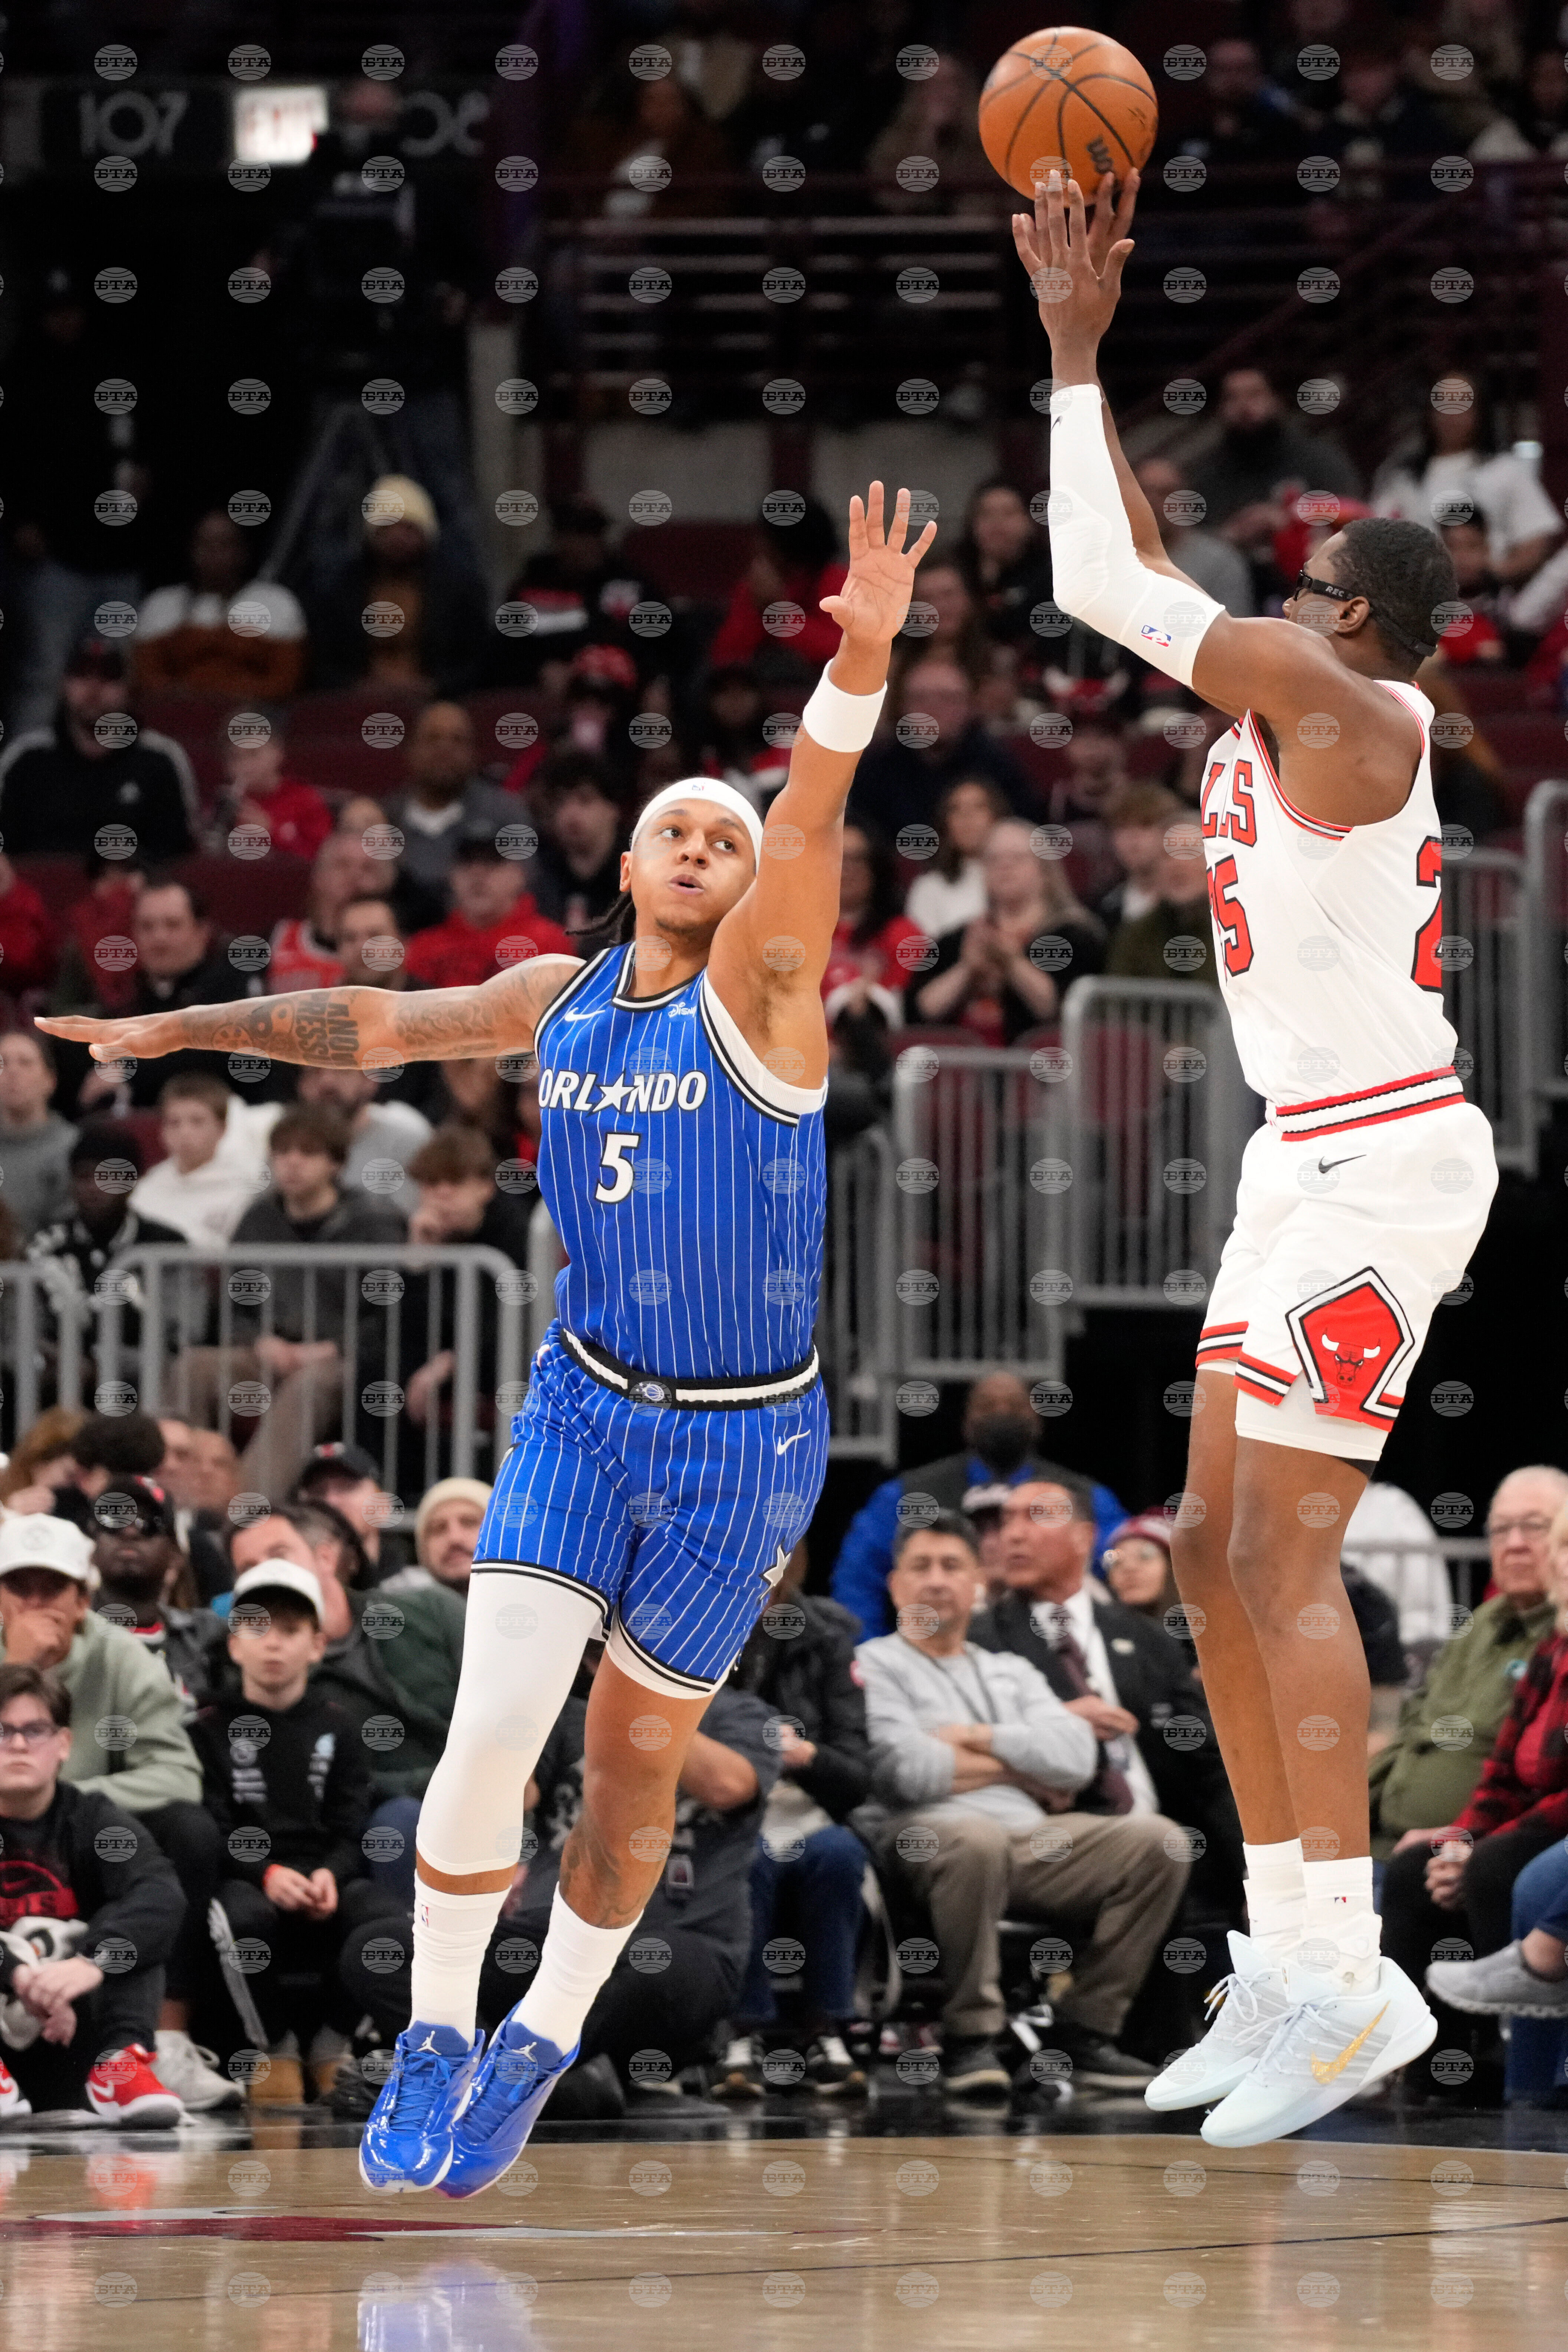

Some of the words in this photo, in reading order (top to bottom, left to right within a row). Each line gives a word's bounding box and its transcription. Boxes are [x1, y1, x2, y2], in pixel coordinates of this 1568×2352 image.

[1326, 586, 1345, 597] REC
[538, 1068, 708, 1117] ORLANDO
[595, 1132, 641, 1204] 5
